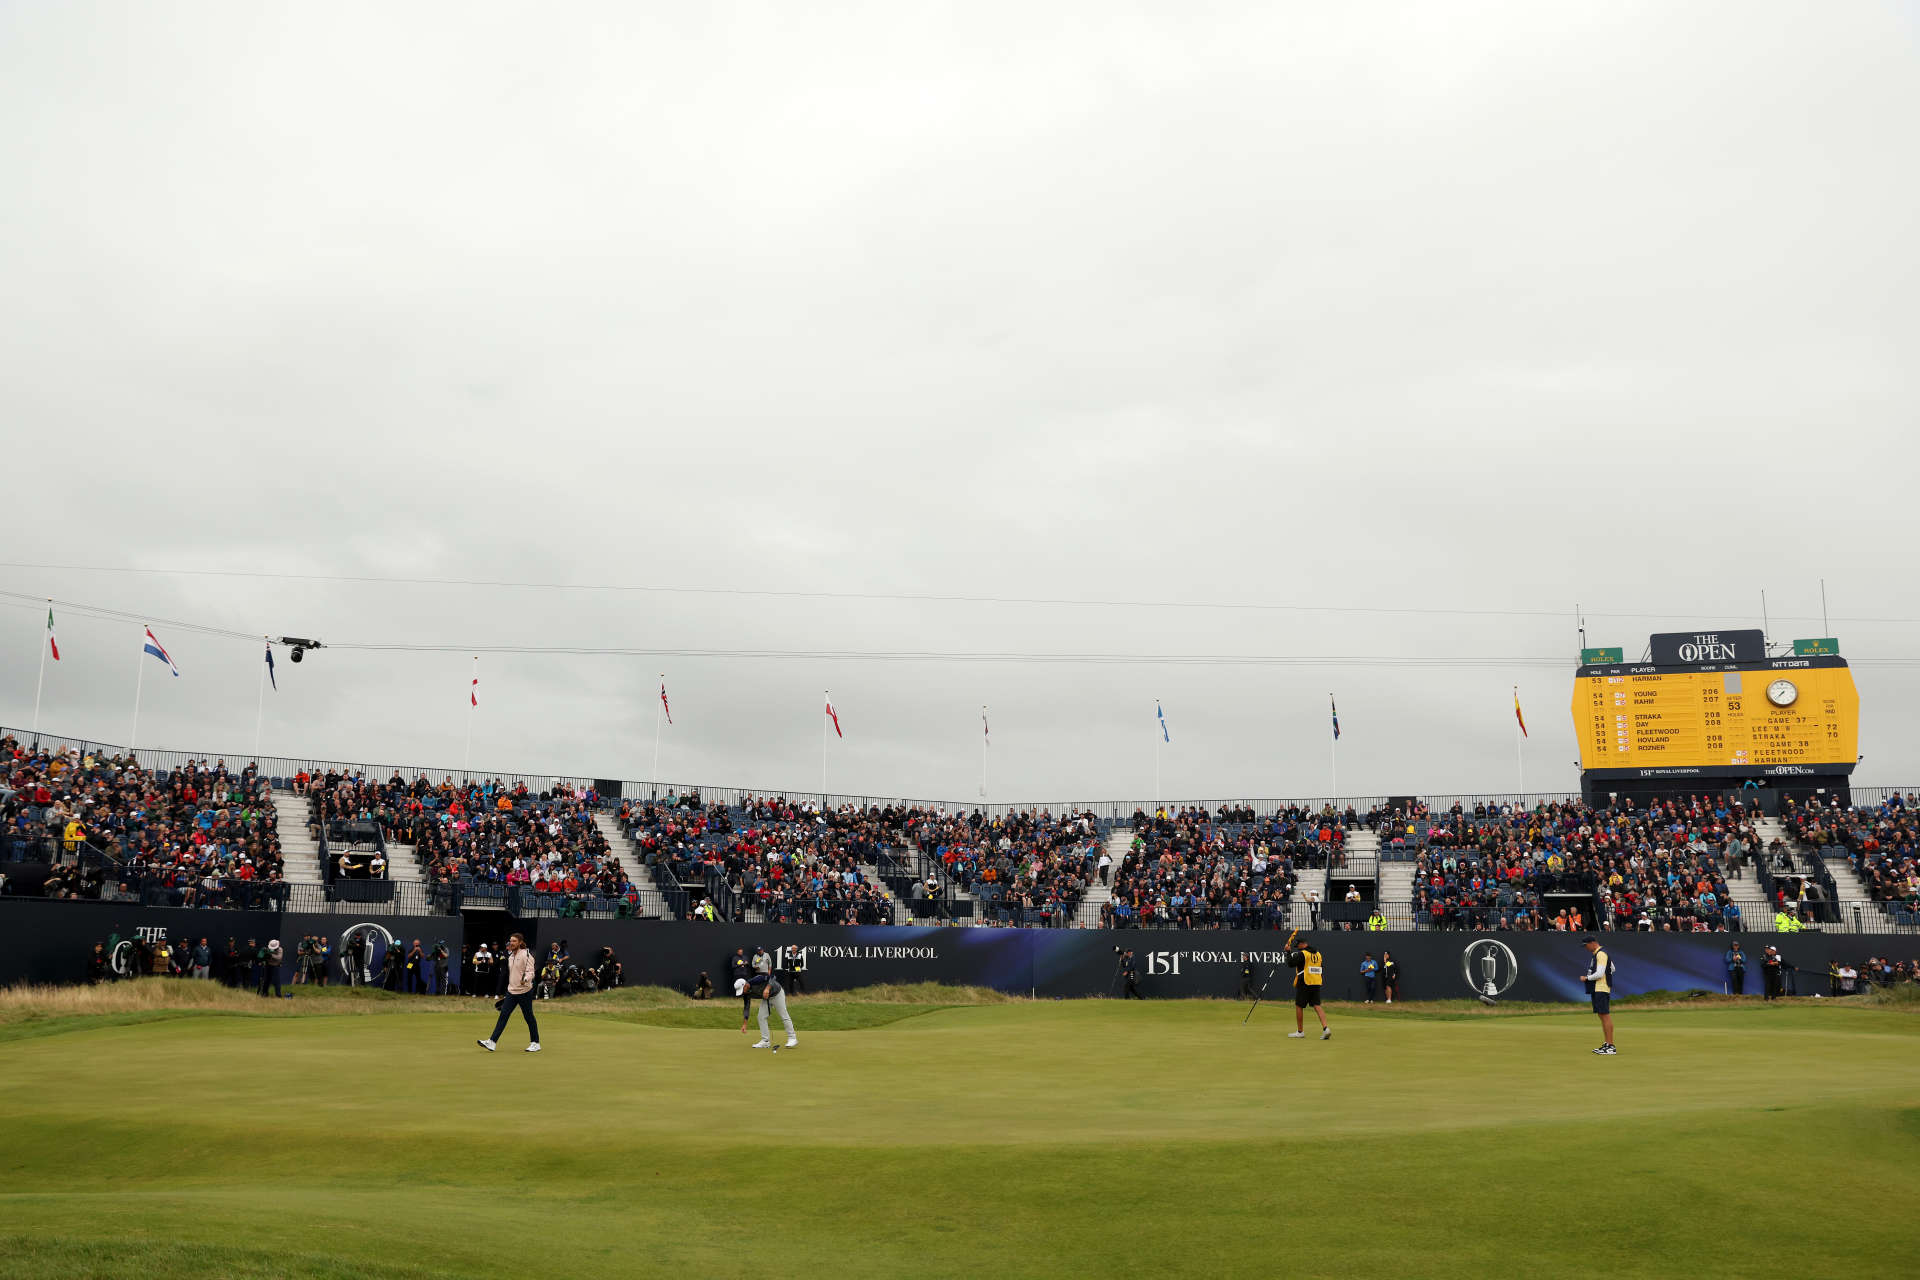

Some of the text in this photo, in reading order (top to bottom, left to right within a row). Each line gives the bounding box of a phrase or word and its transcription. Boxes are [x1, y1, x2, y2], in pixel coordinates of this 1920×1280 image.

[1693, 634, 1719, 644] THE
[1679, 643, 1736, 661] OPEN
[1728, 702, 1740, 710] 53
[136, 926, 167, 944] THE
[820, 946, 862, 958] ROYAL
[865, 946, 938, 959] LIVERPOOL
[1192, 951, 1237, 963] ROYAL
